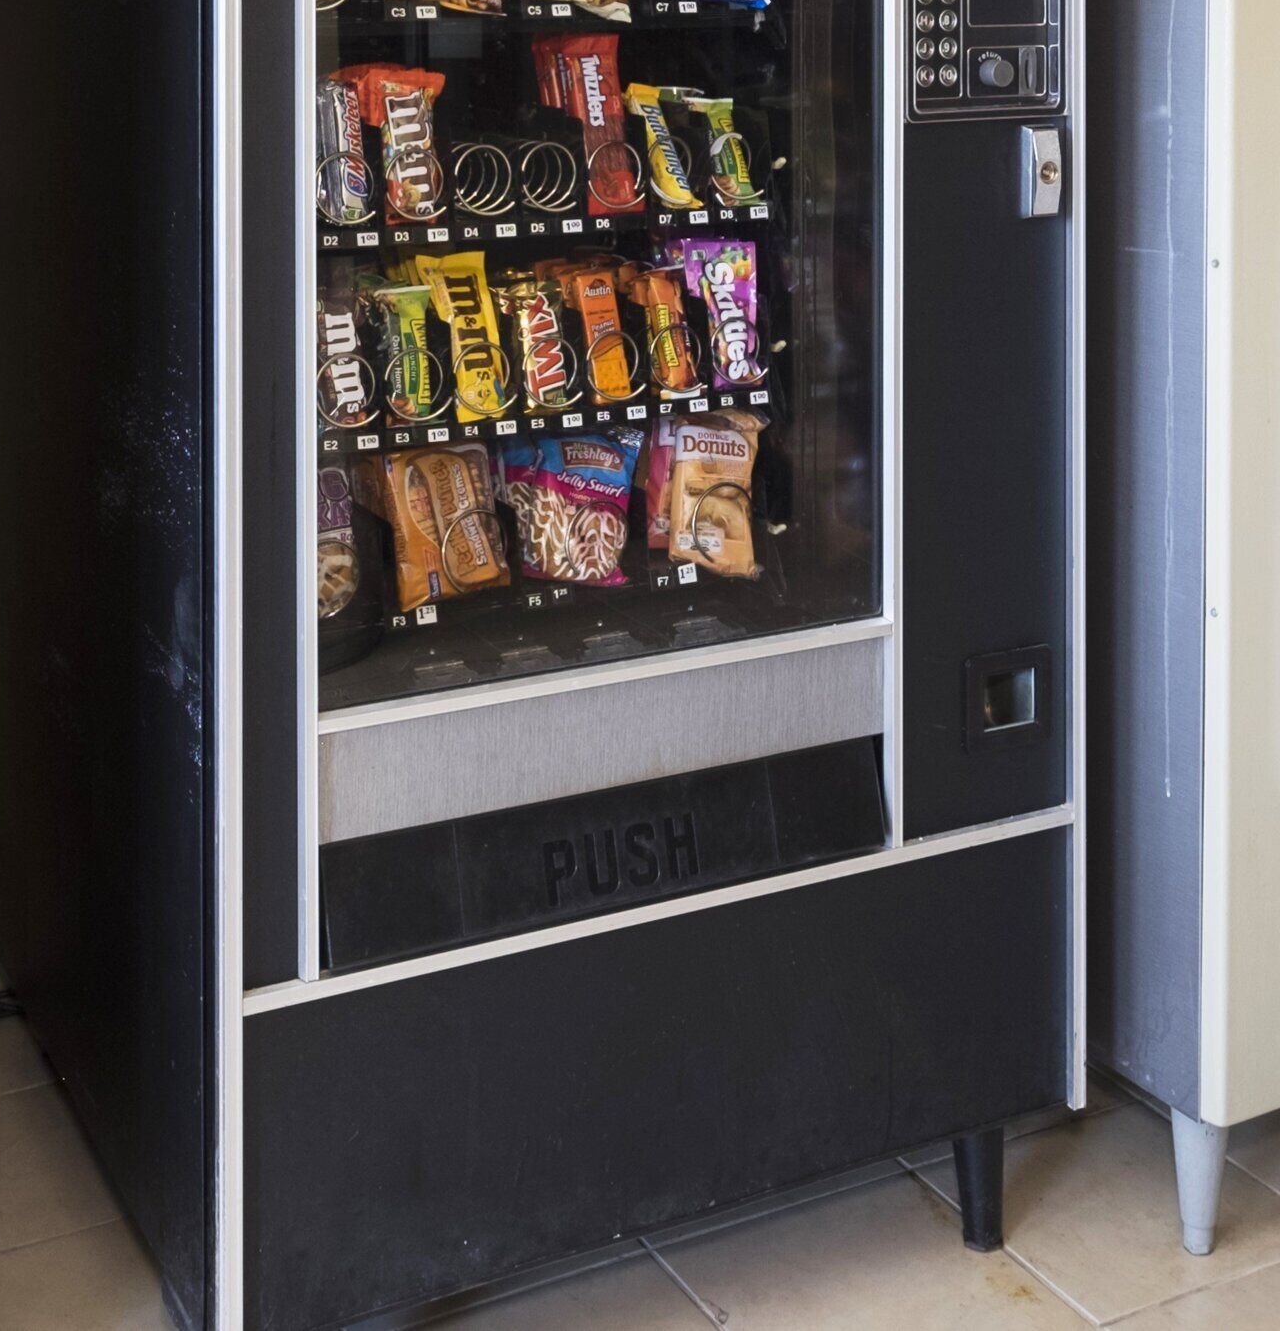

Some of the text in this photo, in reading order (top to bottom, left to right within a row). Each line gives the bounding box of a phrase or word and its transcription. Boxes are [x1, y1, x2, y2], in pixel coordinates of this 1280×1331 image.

[391, 7, 406, 17] C3
[527, 6, 542, 15] C5
[656, 2, 669, 12] C7
[920, 17, 928, 25] H
[920, 42, 950, 53] J 9
[978, 50, 1002, 63] return
[920, 70, 953, 80] K 10
[580, 54, 607, 127] Twizzlers
[640, 103, 690, 191] Butterfinger
[659, 214, 672, 224] D7
[721, 209, 734, 219] D8
[531, 223, 545, 233] D5
[596, 219, 610, 229] D6
[395, 232, 410, 241] D3
[464, 228, 479, 237] D4
[323, 235, 338, 245] D2
[583, 284, 612, 297] Austin
[591, 320, 615, 332] Peanut
[705, 262, 748, 380] Skittles
[444, 273, 494, 381] m&m's
[392, 334, 400, 355] Oats
[528, 294, 565, 402] TWIX
[393, 367, 403, 394] Honey
[721, 396, 734, 406] E8
[597, 411, 610, 421] E6
[531, 418, 545, 428] E5
[465, 426, 479, 436] E4
[395, 433, 410, 443] E3
[324, 439, 338, 450] E2
[682, 435, 746, 458] Donuts
[564, 445, 620, 466] Freshley's
[449, 463, 469, 509] Cremes
[557, 471, 625, 497] Jelly Swirl
[657, 577, 669, 587] F7
[529, 595, 542, 606] F5
[392, 616, 407, 626] F3
[541, 811, 702, 909] PUSH
